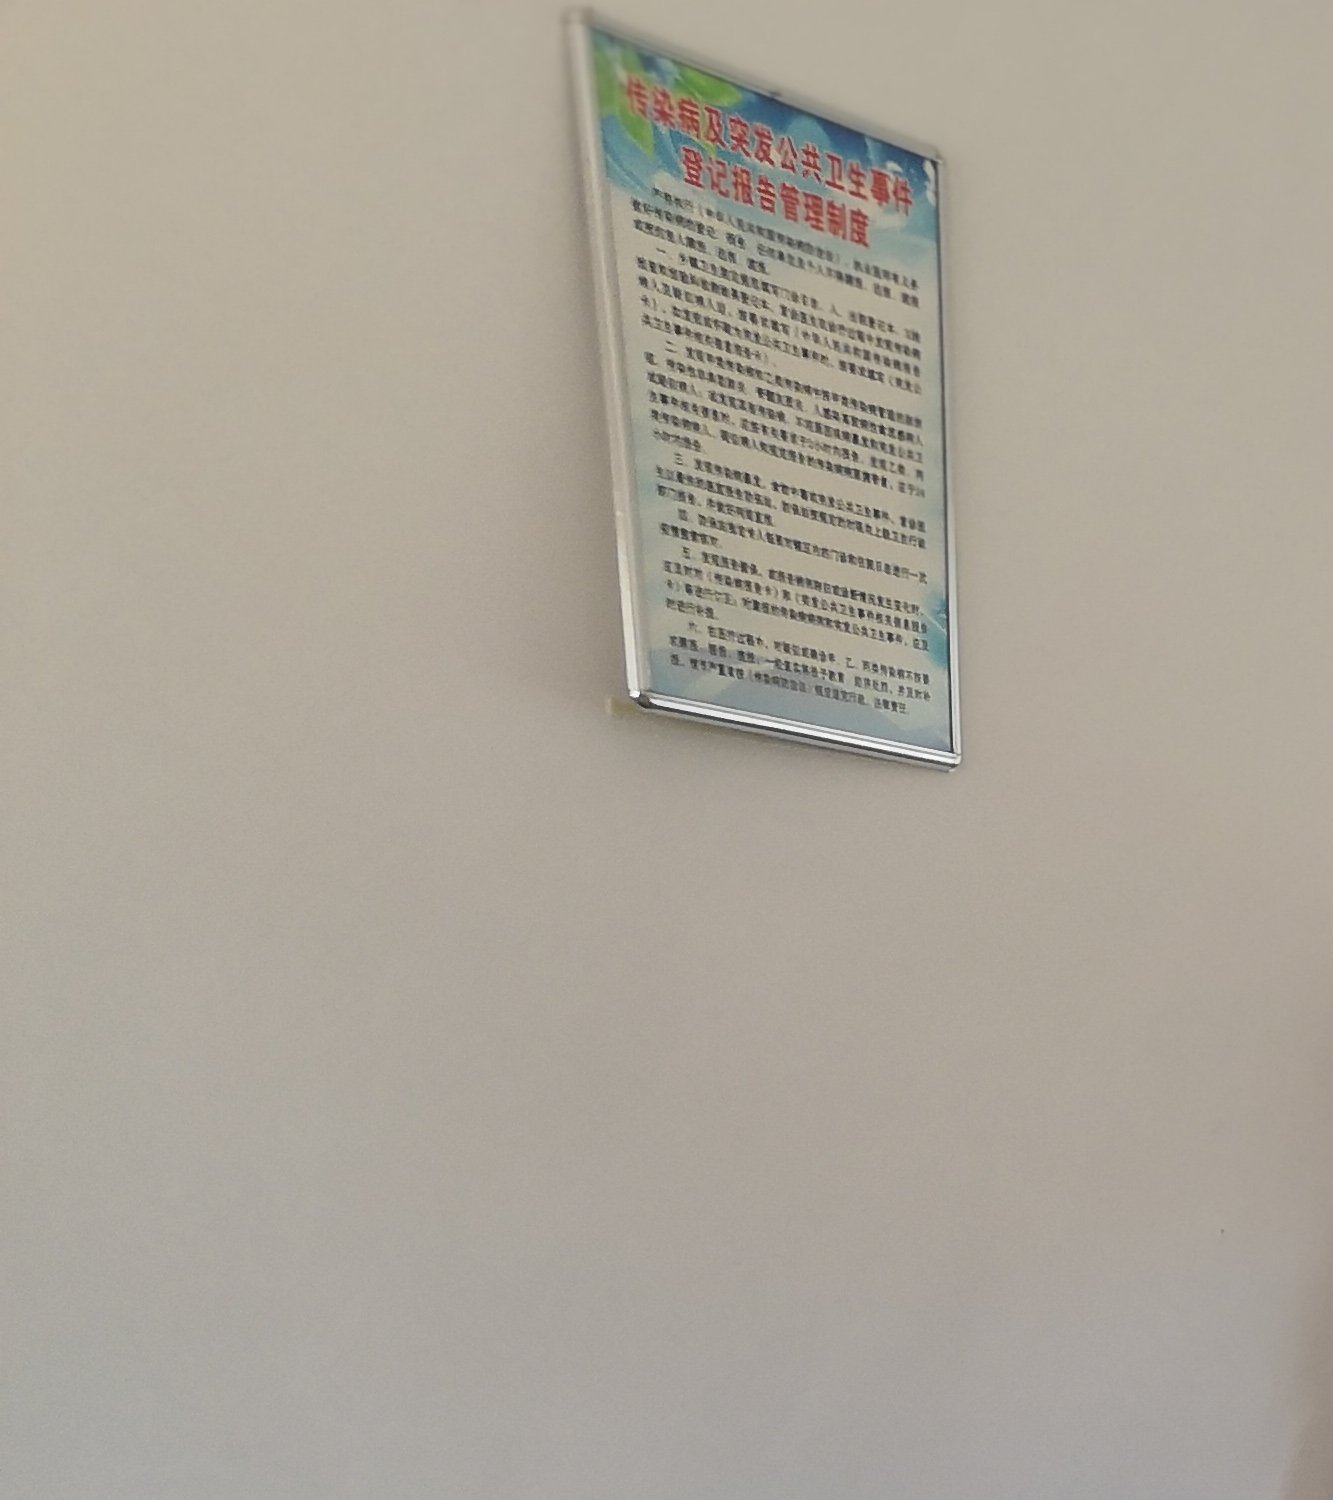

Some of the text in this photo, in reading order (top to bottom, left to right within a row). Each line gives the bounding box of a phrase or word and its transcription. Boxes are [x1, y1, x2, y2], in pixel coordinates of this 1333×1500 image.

[626, 75, 913, 216] 传染病及突发公共卫生事件
[681, 147, 870, 248] 登记报告管理制度
